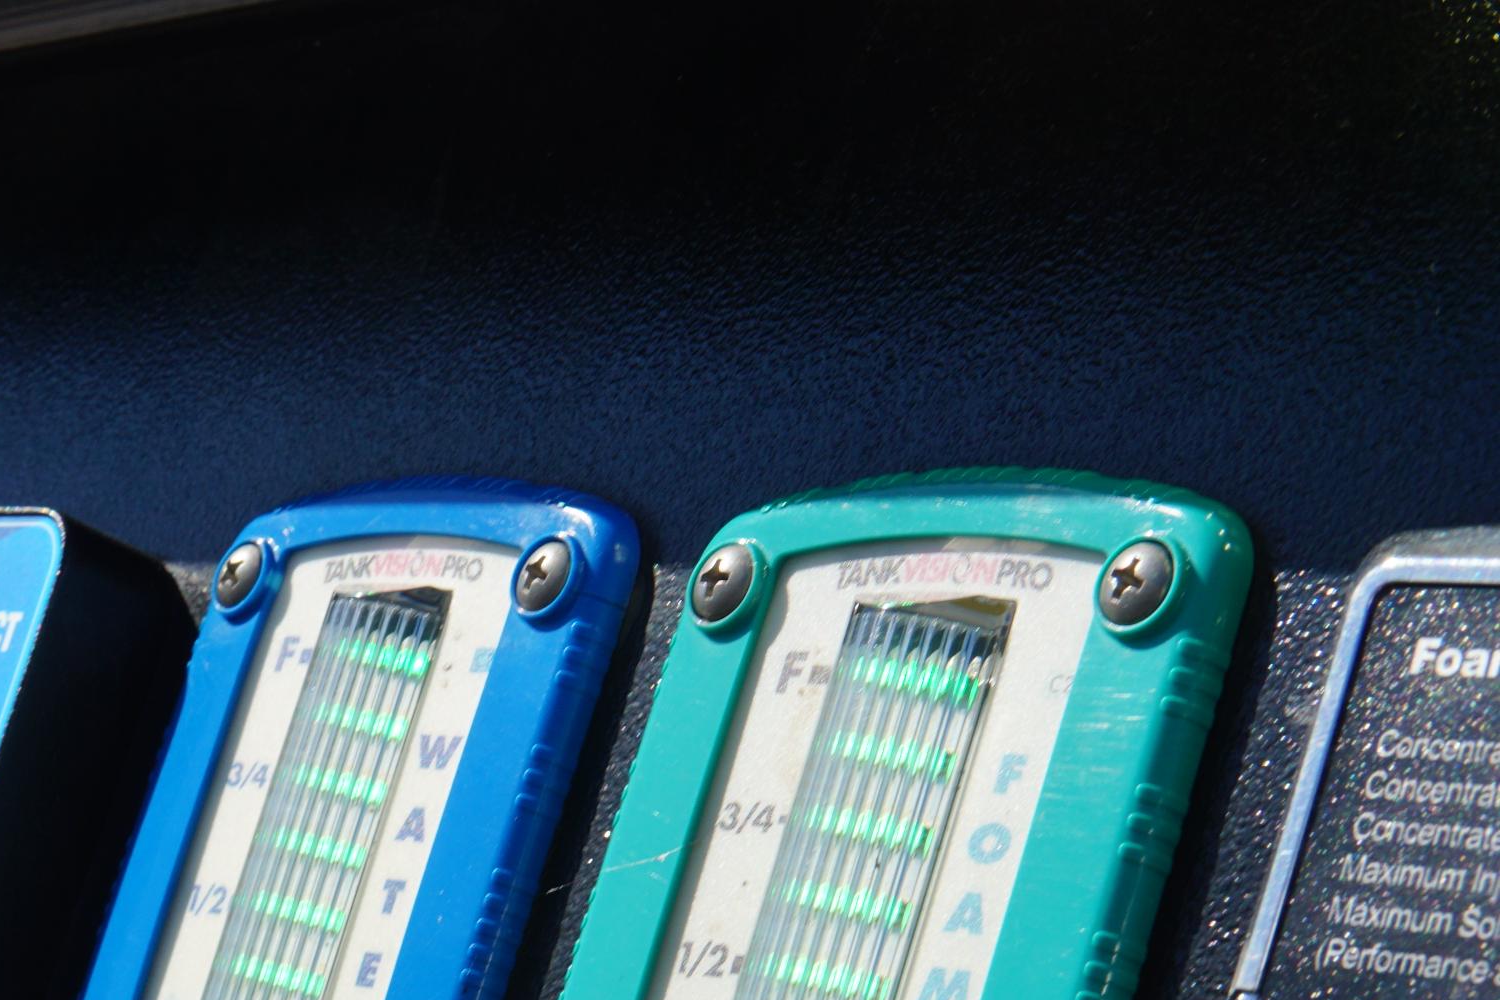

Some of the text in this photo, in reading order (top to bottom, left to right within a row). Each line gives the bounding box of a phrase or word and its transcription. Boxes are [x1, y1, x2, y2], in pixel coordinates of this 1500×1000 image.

[274, 636, 301, 672] F
[775, 650, 809, 695] F
[226, 761, 269, 790] 3/4
[718, 801, 777, 834] 3/4
[1338, 851, 1467, 892] Maximum
[1326, 894, 1453, 935] Maximum
[678, 939, 729, 978] 1/2
[1314, 936, 1490, 985] (Performance
